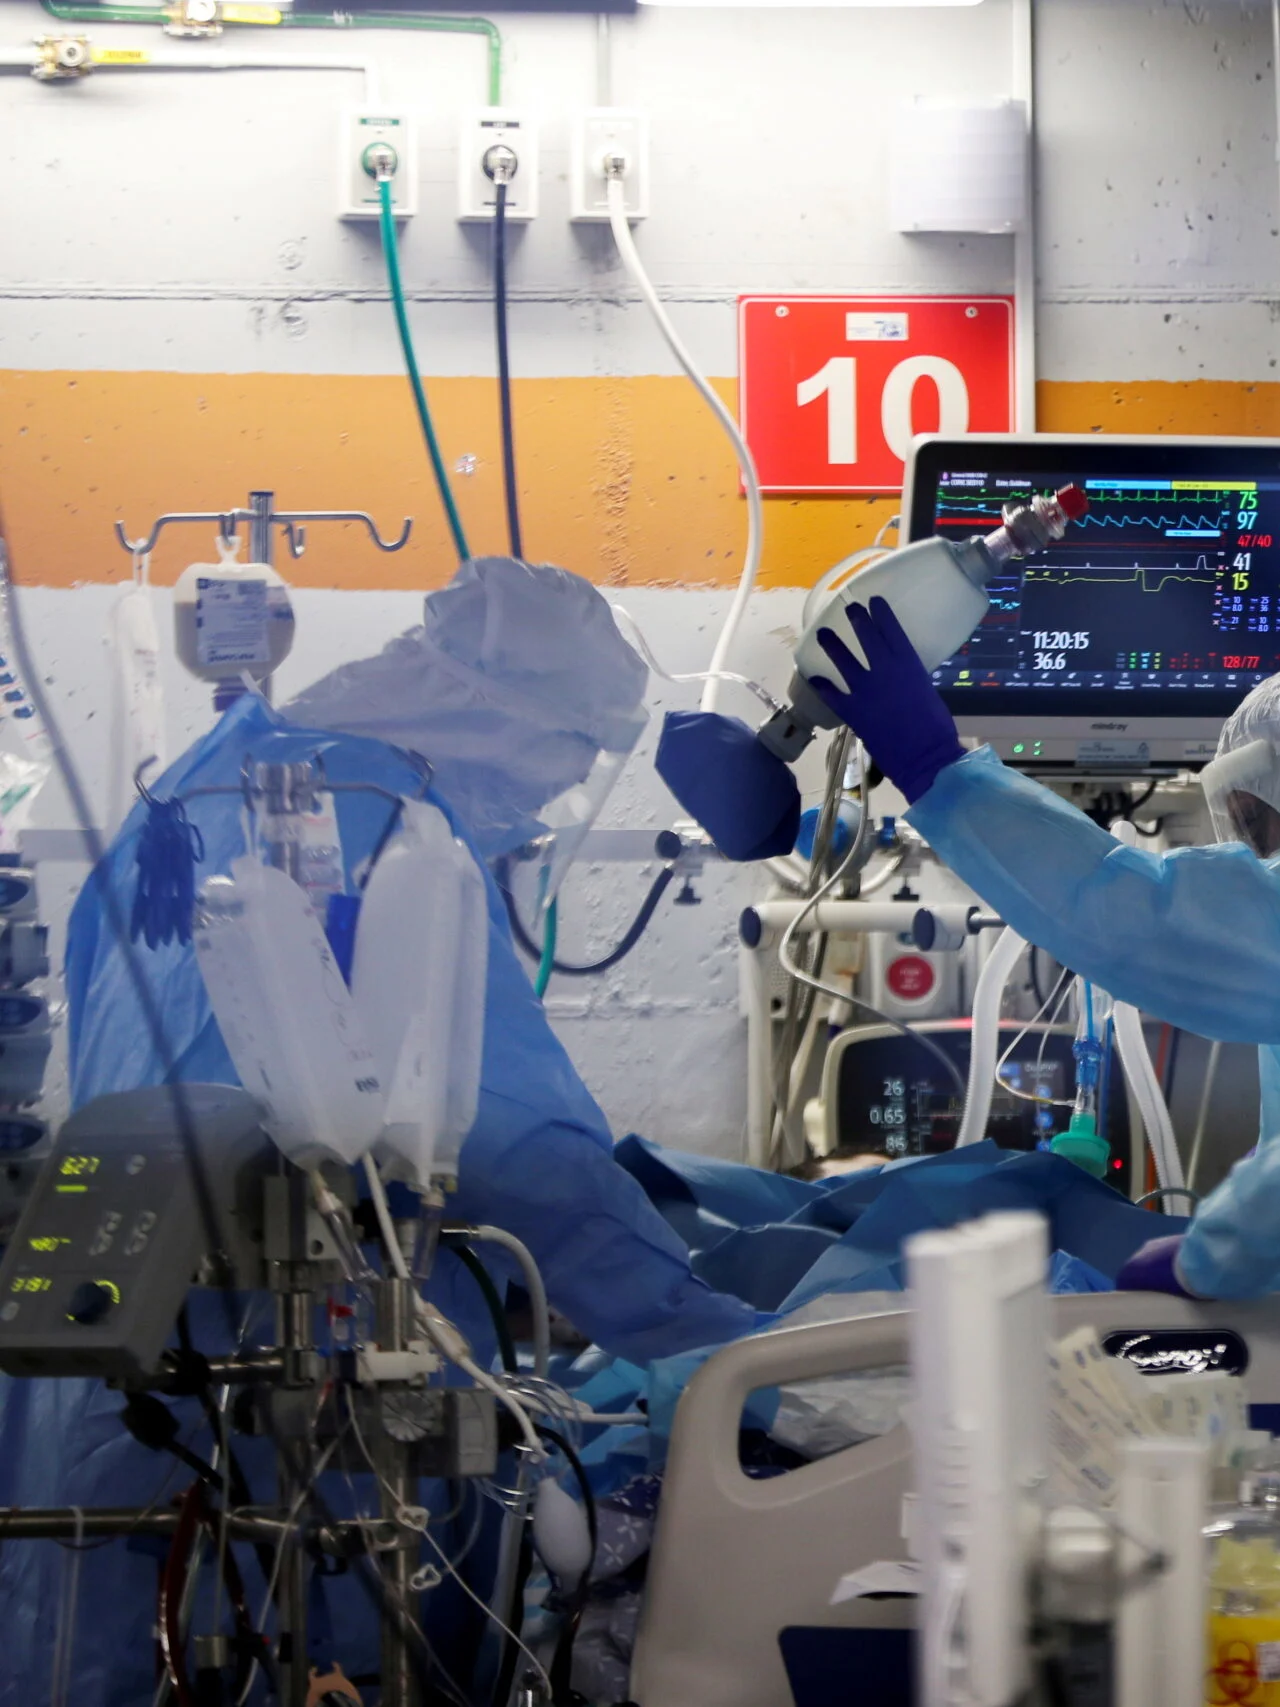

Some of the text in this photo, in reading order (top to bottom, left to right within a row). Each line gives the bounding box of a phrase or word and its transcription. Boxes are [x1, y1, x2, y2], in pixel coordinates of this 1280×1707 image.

[797, 355, 969, 464] 10
[1239, 491, 1258, 509] 75
[1237, 511, 1258, 530] 97
[1233, 552, 1251, 570] 41
[1232, 572, 1249, 590] 15
[1033, 631, 1090, 649] 11:20:15
[1033, 652, 1067, 669] 36.6
[1223, 656, 1260, 668] 128/77
[882, 1079, 905, 1096] 26
[869, 1106, 906, 1124] 0.65
